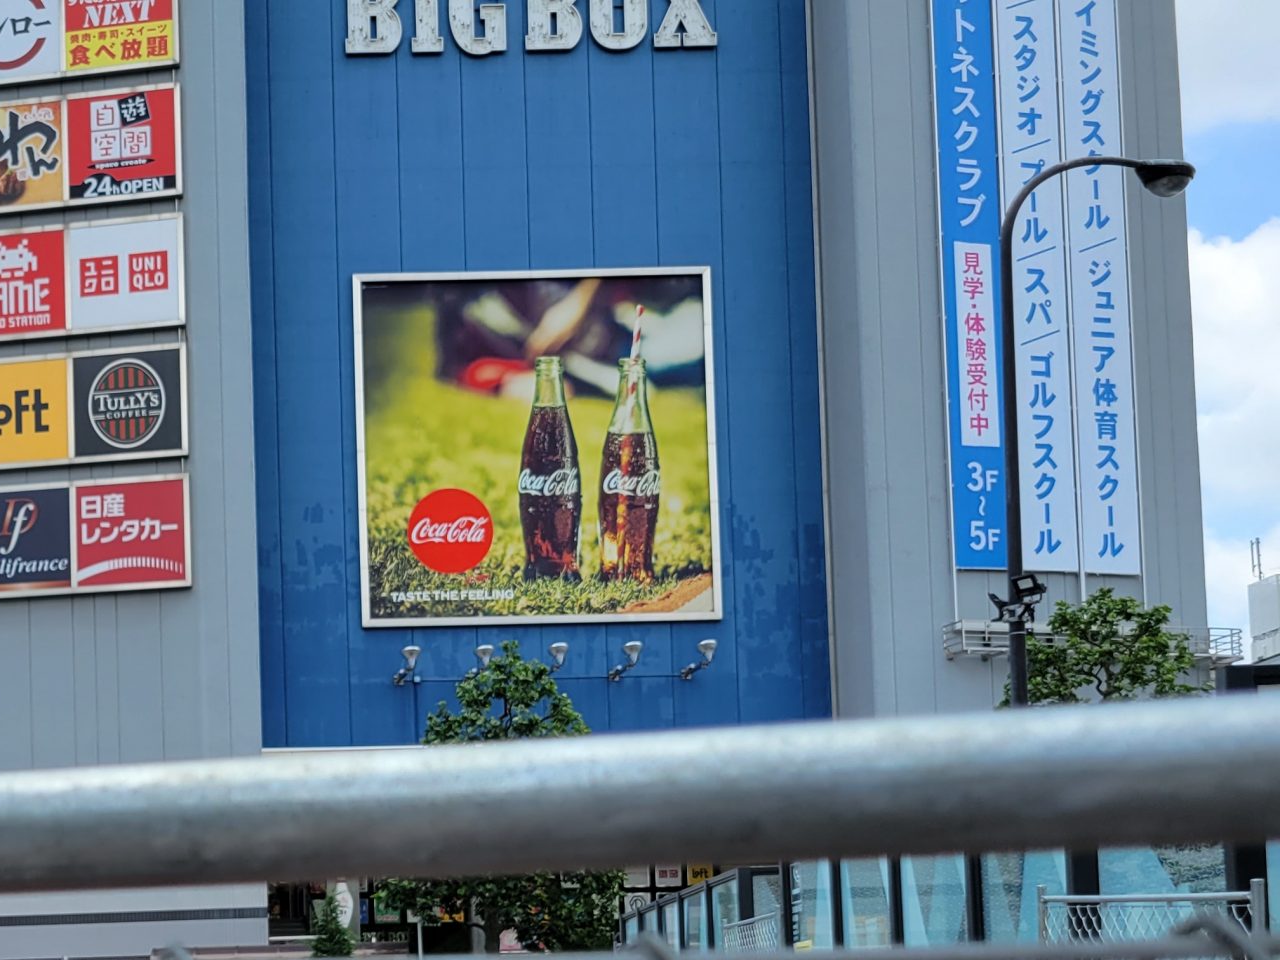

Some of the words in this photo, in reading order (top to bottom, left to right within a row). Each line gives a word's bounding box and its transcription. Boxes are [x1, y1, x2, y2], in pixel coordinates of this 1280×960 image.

[83, 0, 156, 28] NEXT
[70, 35, 168, 66] 食べ放題
[950, 0, 987, 228] トネスクラブ
[8, 313, 51, 329] STATION
[106, 409, 147, 420] COFFEE
[81, 493, 125, 519] 日産
[81, 518, 178, 545] レンタカー
[411, 516, 489, 544] Coca-Cola
[391, 591, 430, 602] TASTE
[434, 589, 459, 600] THE
[460, 588, 514, 600] FEELING
